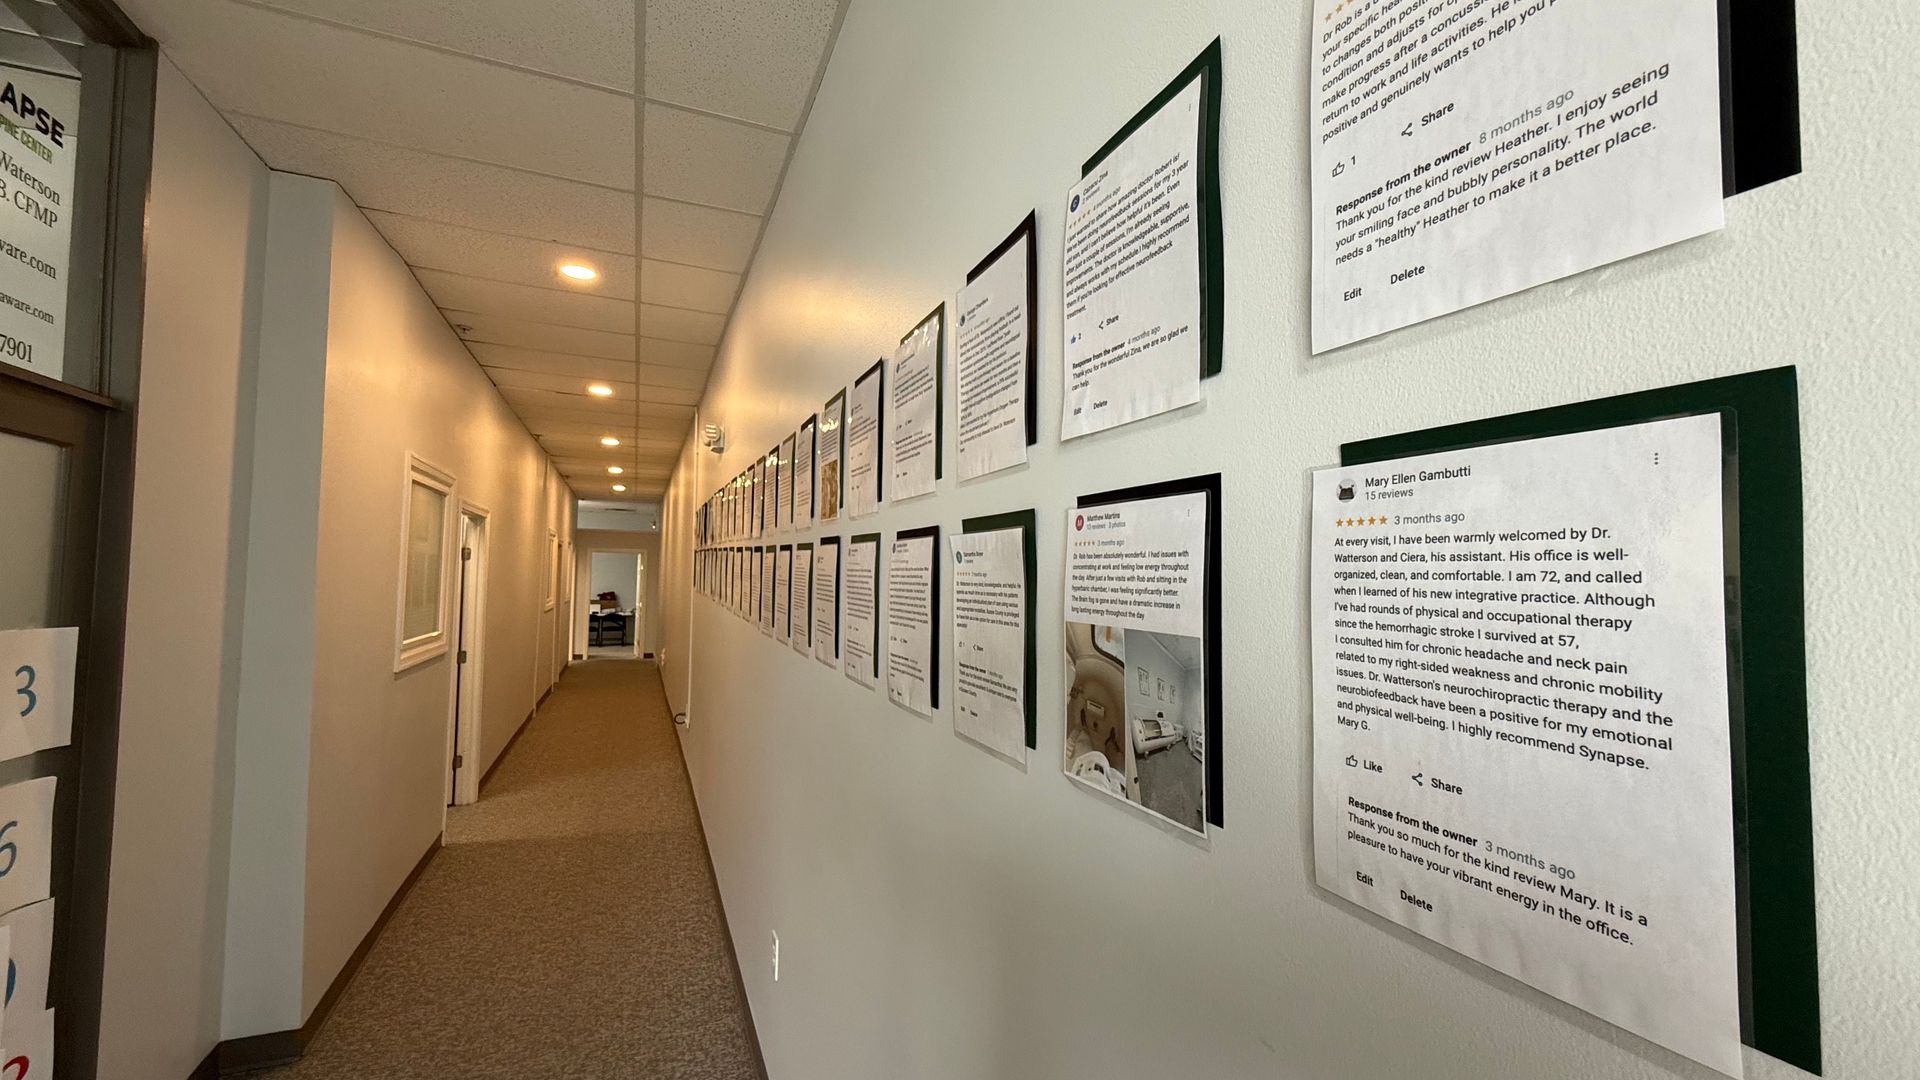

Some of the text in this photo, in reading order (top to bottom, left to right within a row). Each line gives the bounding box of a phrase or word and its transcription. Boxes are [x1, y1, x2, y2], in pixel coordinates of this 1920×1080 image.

[1321, 1, 1444, 91] condition and adjusts for
[1322, 0, 1545, 144] positive and genuinely wants to help you
[1420, 102, 1454, 126] Share
[1335, 210, 1365, 230] Thank
[1365, 202, 1385, 220] you
[1386, 193, 1402, 207] for
[1403, 184, 1422, 199] the
[1424, 168, 1448, 189] kind
[1451, 150, 1492, 176] review
[1494, 121, 1552, 156] Heather.
[1564, 93, 1607, 121] enjoy
[1611, 63, 1669, 99] seeing
[1335, 186, 1383, 215] Response
[1384, 172, 1410, 191] from
[1412, 162, 1431, 177] the
[1433, 141, 1471, 166] owner
[1490, 106, 1542, 138] months
[1545, 90, 1574, 110] ago
[1335, 89, 1658, 251] your smiling face and bubbly personality. The world
[14, 190, 57, 228] CFMP
[1389, 265, 1425, 284] Delete
[1343, 287, 1362, 301] Edit
[1364, 465, 1471, 488] Mary Ellen Gambutti
[1364, 487, 1413, 500] 15 reviews
[1402, 512, 1442, 524] months
[1443, 512, 1465, 524] ago
[1333, 537, 1344, 547] At
[1344, 538, 1368, 548] every
[1369, 535, 1391, 546] visit,
[1398, 534, 1422, 544] have
[1424, 533, 1450, 544] been
[1452, 531, 1495, 544] warmly
[1497, 528, 1566, 541] welcomed
[1569, 527, 1587, 542] by
[1590, 526, 1610, 538] Dr.
[1333, 547, 1628, 563] Watterson and Ciera, his assistant. His office is well-
[1333, 601, 1632, 632] I've had rounds of physical and occupational therapy
[15, 664, 37, 717] 3
[1336, 684, 1419, 705] neurobiofeedback
[1420, 695, 1446, 710] have
[1447, 700, 1476, 715] been
[1489, 710, 1539, 726] positive
[1541, 716, 1562, 730] for
[1565, 723, 1588, 738] my
[1591, 728, 1672, 750] emotional
[1336, 714, 1370, 731] Mary G.
[1362, 759, 1382, 773] Like
[1430, 777, 1463, 795] Share
[1347, 796, 1393, 819] Response
[1394, 811, 1419, 828] from
[1421, 820, 1439, 834] the
[1441, 828, 1478, 846] owner
[1496, 846, 1545, 869] months
[1548, 863, 1575, 879] ago
[1347, 830, 1633, 945] pleasure to have your vibrant energy in the office.
[1355, 870, 1373, 887] Edit
[1399, 889, 1433, 912] Delete
